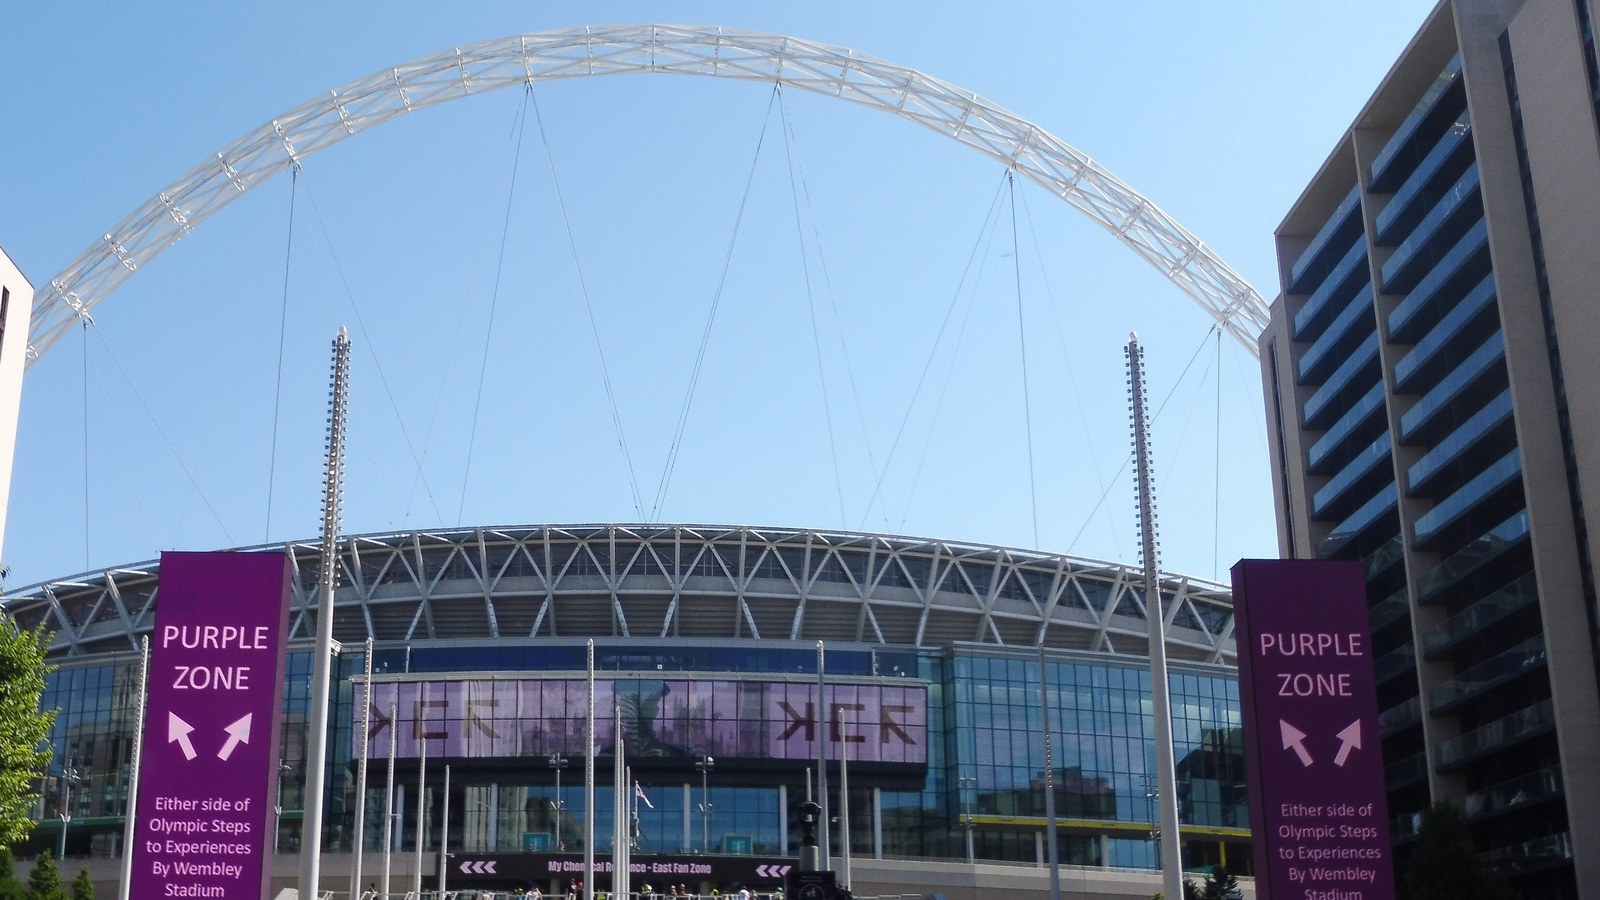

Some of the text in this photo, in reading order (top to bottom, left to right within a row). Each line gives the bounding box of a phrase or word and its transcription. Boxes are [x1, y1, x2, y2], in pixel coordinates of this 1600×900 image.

[162, 625, 269, 650] PURPLE
[1260, 633, 1363, 656] PURPLE
[172, 665, 251, 690] ZONE
[1277, 673, 1352, 697] ZONE
[155, 797, 250, 811] Either side of
[1281, 803, 1373, 817] Either side of
[149, 817, 251, 834] Olympic Steps
[1279, 825, 1377, 841] Olympic Steps
[146, 841, 251, 856] to Experiences
[1279, 847, 1381, 862] to Experiences
[152, 861, 243, 879] By Wembley
[548, 861, 562, 872] My
[652, 863, 672, 873] East
[673, 863, 689, 873] Fan
[690, 864, 711, 873] Zone
[1289, 867, 1376, 882] By Wembley
[164, 883, 225, 897] Stadium
[1304, 889, 1362, 900] Stadium
